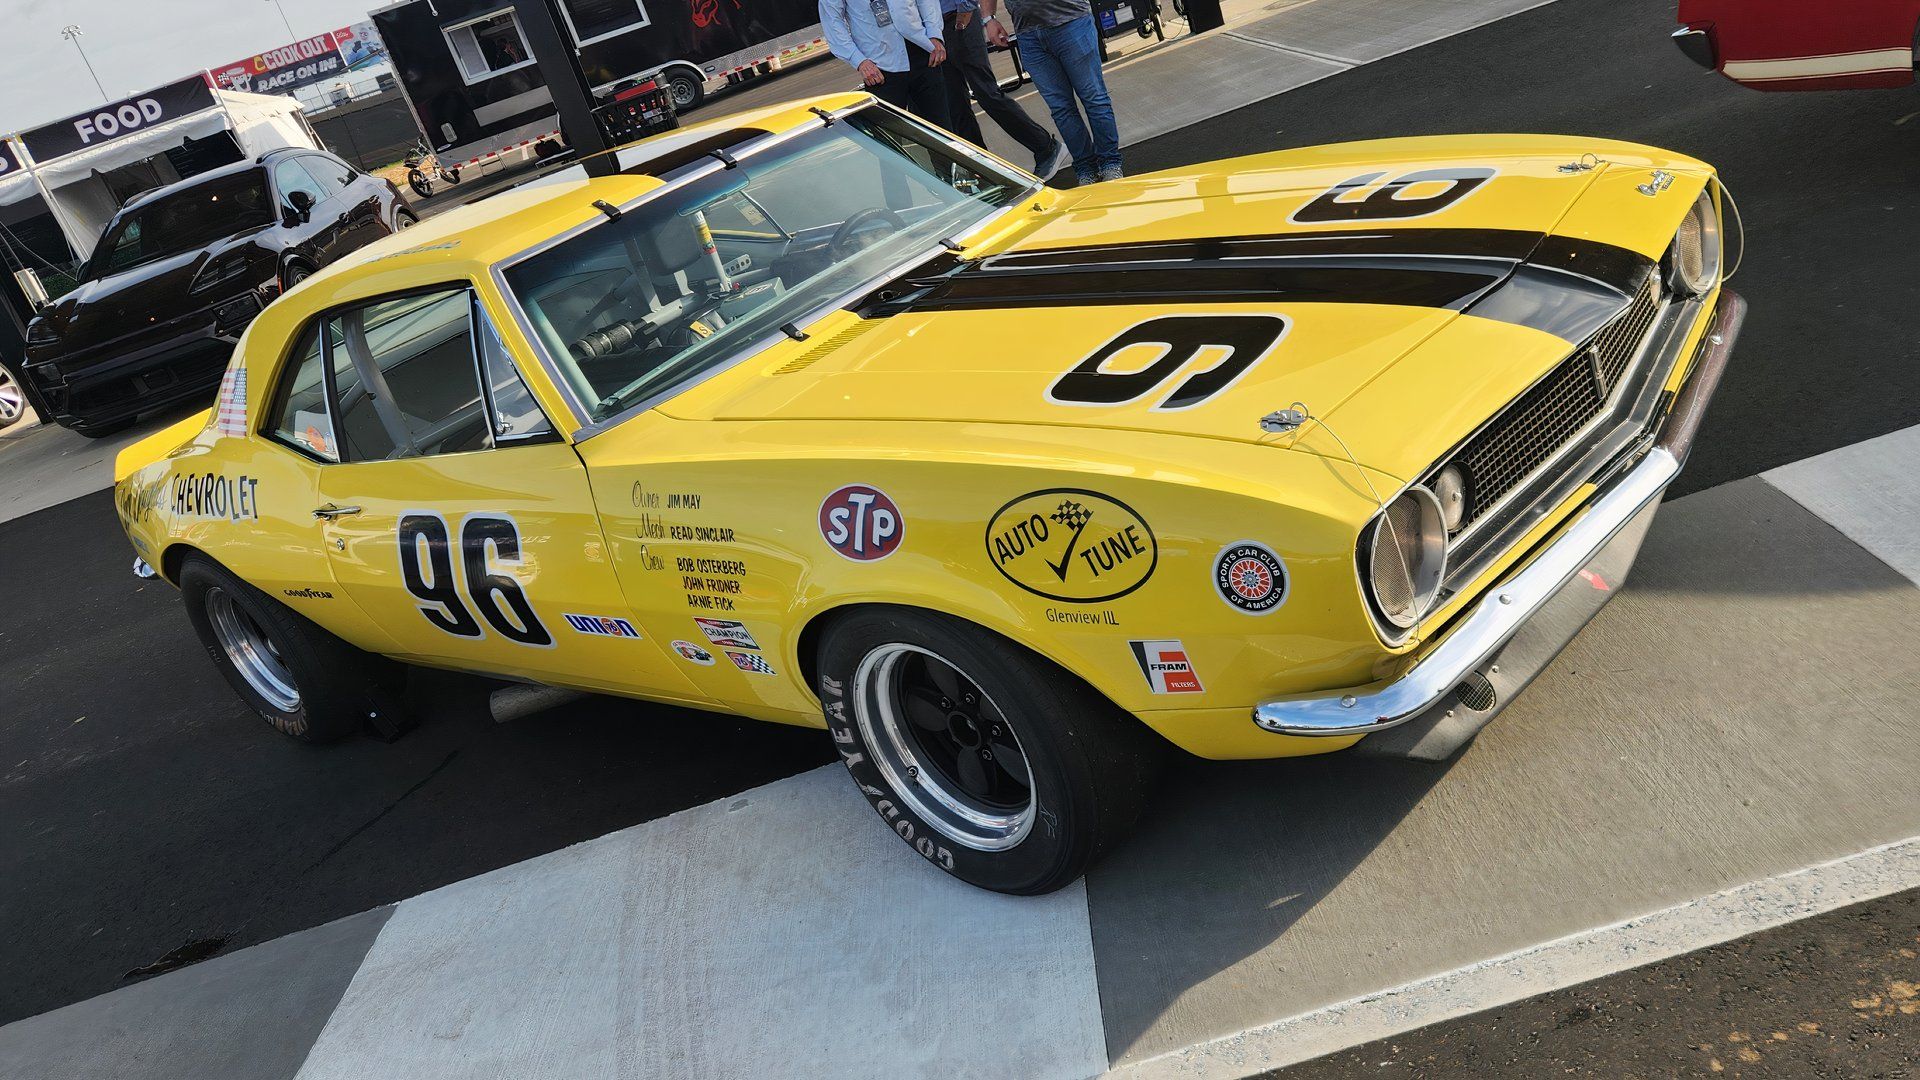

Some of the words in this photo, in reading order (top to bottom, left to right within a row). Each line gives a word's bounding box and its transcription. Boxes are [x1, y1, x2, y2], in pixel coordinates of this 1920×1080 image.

[262, 42, 303, 69] COOK
[300, 36, 327, 59] OUT
[258, 71, 295, 92] RACE
[296, 63, 317, 79] ON
[319, 57, 337, 72] IN!
[73, 98, 163, 144] FOOD
[171, 473, 258, 520] CHEVROLET
[667, 494, 681, 508] JIM
[683, 494, 701, 509] MAY
[670, 526, 693, 541] READ
[695, 527, 736, 542] SINCLAIR
[826, 492, 897, 554] STP
[994, 514, 1049, 565] AUTO
[1080, 525, 1146, 577] TUNE
[641, 545, 665, 570] Crew
[677, 557, 695, 572] BOB
[696, 559, 746, 576] OSTERBERG
[1220, 553, 1237, 588] SPORTS
[1237, 549, 1258, 557] CAR
[1260, 554, 1280, 577] CLUB
[397, 510, 556, 648] 96
[683, 576, 704, 590] JOHN
[706, 578, 742, 594] FRIDNER
[283, 588, 334, 599] GOODYEAR
[687, 594, 713, 609] ARNIE
[714, 596, 735, 611] FICK
[1231, 594, 1243, 604] OF
[1246, 587, 1282, 609] AMERICA
[1046, 608, 1100, 624] Glenview
[704, 627, 749, 640] CHAMPION
[1150, 663, 1187, 671] FRAM
